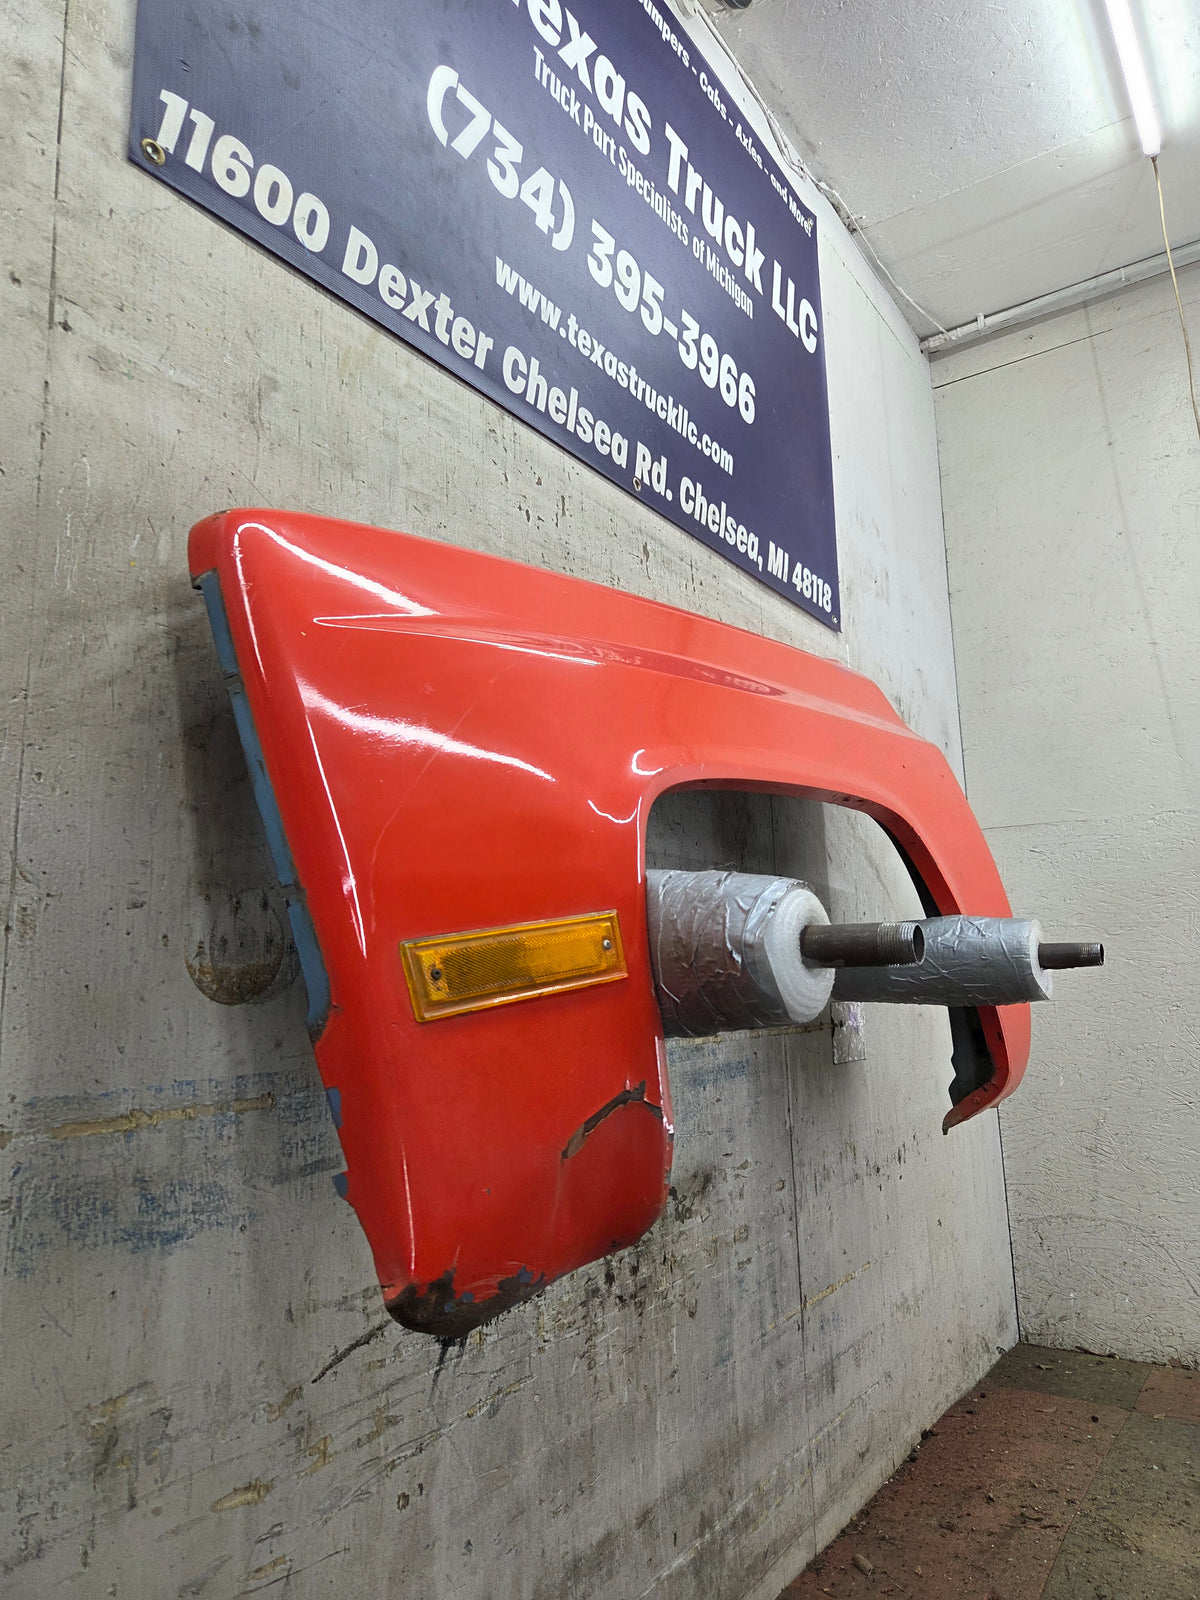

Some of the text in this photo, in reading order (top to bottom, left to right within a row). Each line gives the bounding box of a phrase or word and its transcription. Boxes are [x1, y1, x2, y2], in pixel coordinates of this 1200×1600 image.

[427, 65, 756, 424] (734) 395-3966
[512, 0, 818, 353] exas Truck LLC
[534, 45, 754, 319] Truck Part Specialists of Michigan
[638, 0, 690, 67] umpers
[700, 72, 727, 120] Cabs
[735, 123, 763, 170] Axles
[770, 173, 788, 204] and
[156, 89, 832, 613] 11600 Dexter Chelsea Rd. Chelsea, MI 48118
[496, 256, 734, 475] www.texastruckllc.com
